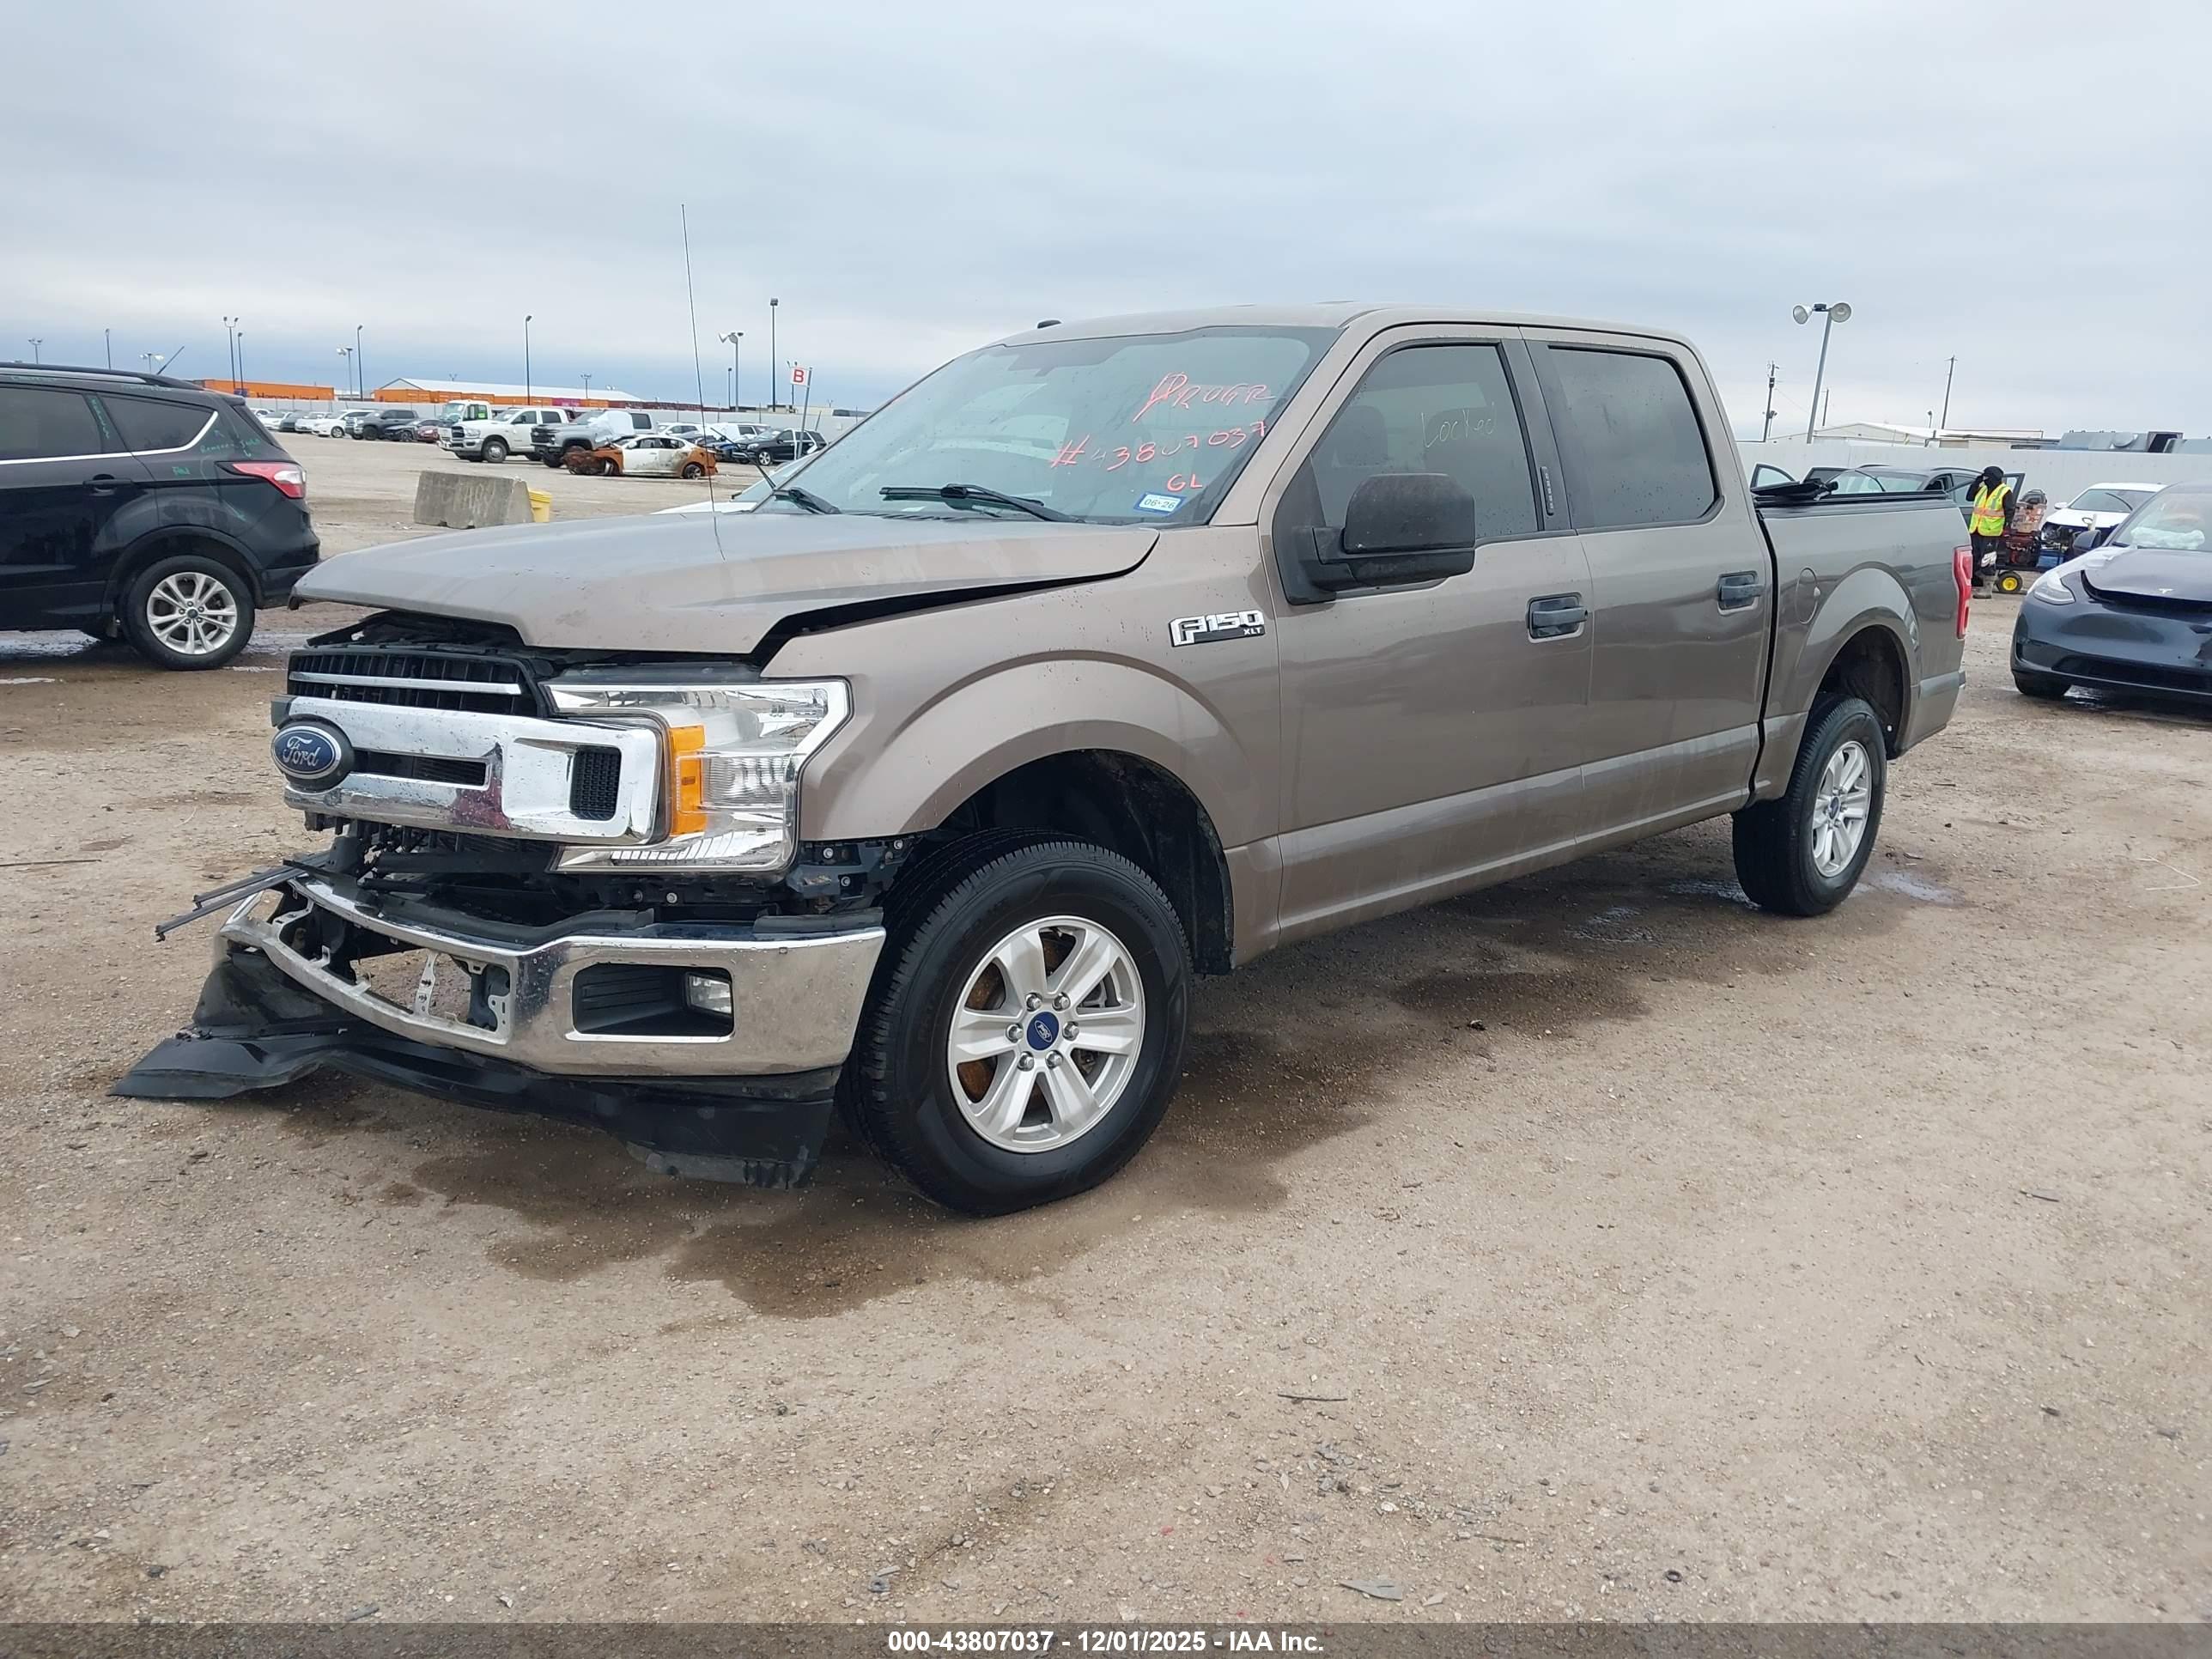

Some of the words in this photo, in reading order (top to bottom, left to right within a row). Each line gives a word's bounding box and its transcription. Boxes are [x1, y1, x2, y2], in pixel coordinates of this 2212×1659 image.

[793, 368, 805, 383] B
[1243, 627, 1262, 635] XLT
[283, 736, 320, 767] Ford
